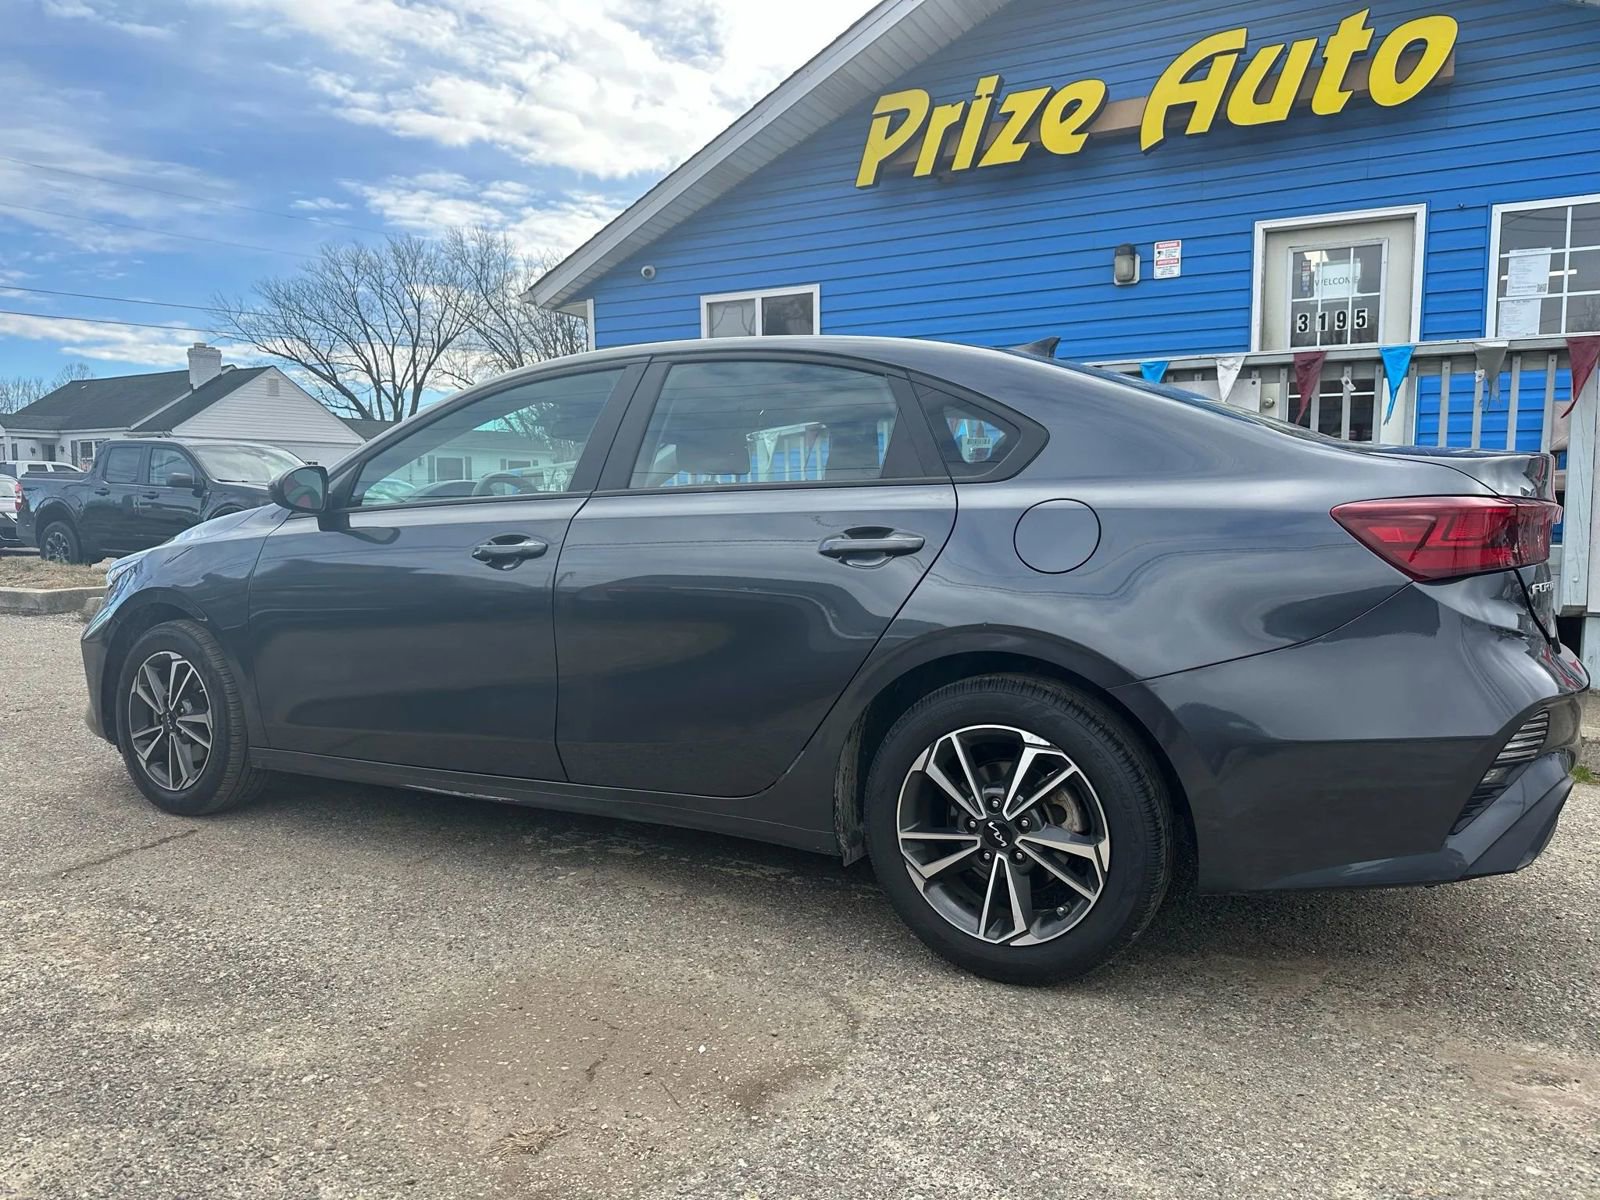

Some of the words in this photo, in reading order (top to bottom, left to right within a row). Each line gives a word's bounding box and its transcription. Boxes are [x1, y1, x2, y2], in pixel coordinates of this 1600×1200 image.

[855, 74, 1106, 189] Prize
[1140, 8, 1459, 152] Auto
[1298, 309, 1366, 332] 3195
